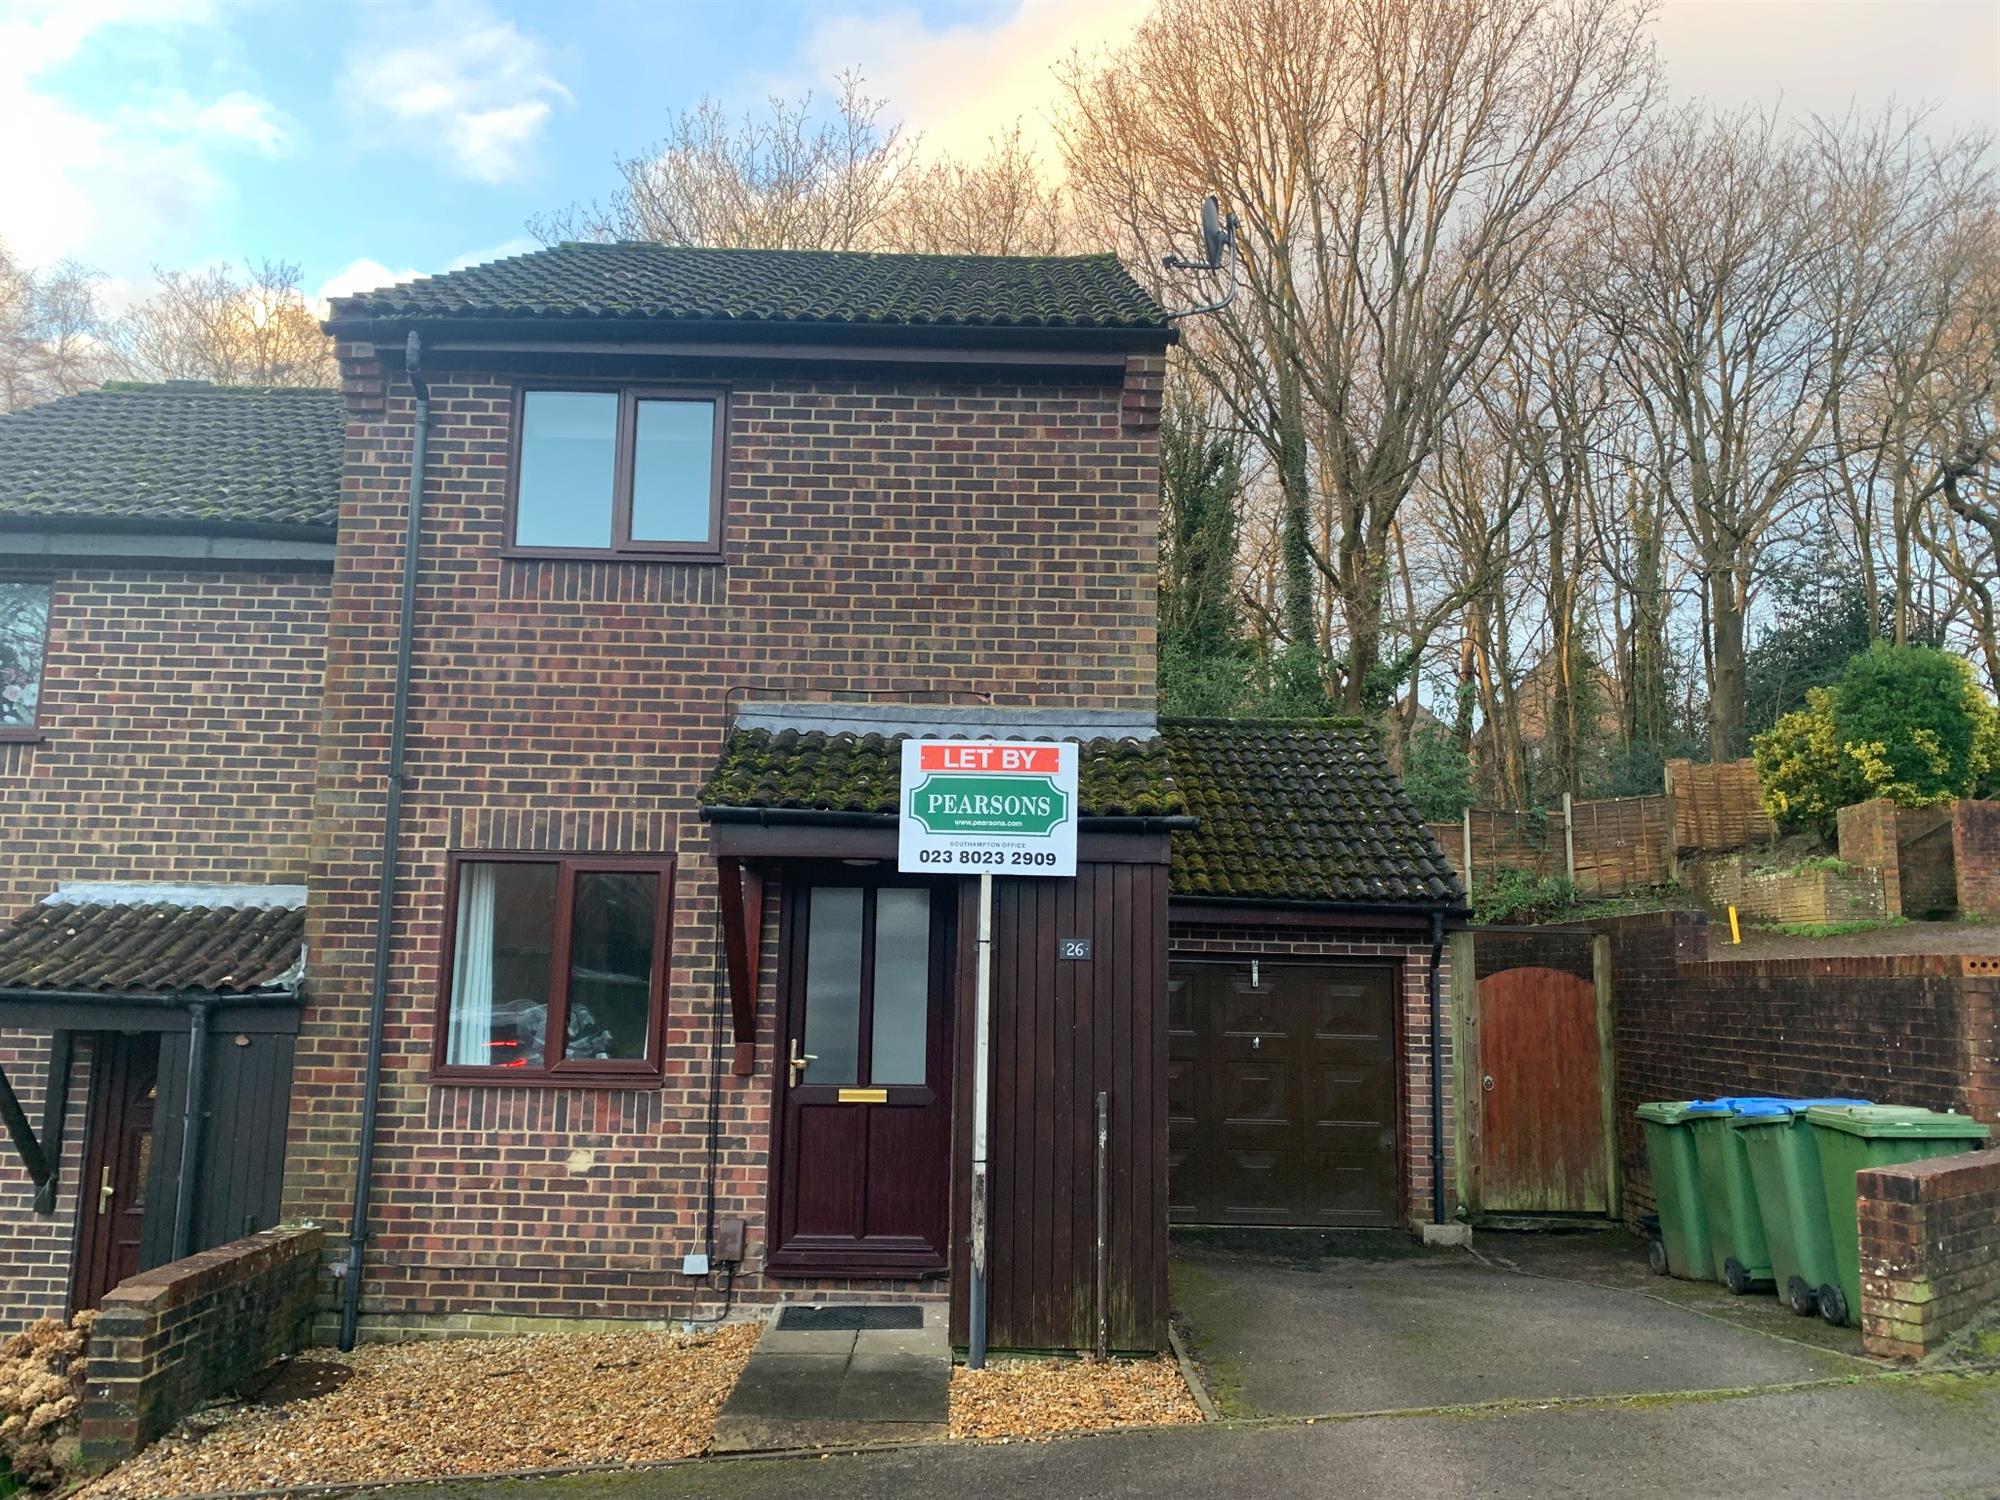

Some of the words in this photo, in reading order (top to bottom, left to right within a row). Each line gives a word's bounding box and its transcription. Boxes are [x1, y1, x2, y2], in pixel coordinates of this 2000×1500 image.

[943, 748, 993, 768] LET
[1002, 749, 1038, 769] BY
[927, 794, 1051, 816] PEARSONS
[954, 818, 1023, 828] www.pearsons.com
[919, 850, 952, 863] 023
[959, 850, 1004, 864] 8023
[1011, 852, 1056, 866] 2909
[1066, 942, 1084, 957] 26
